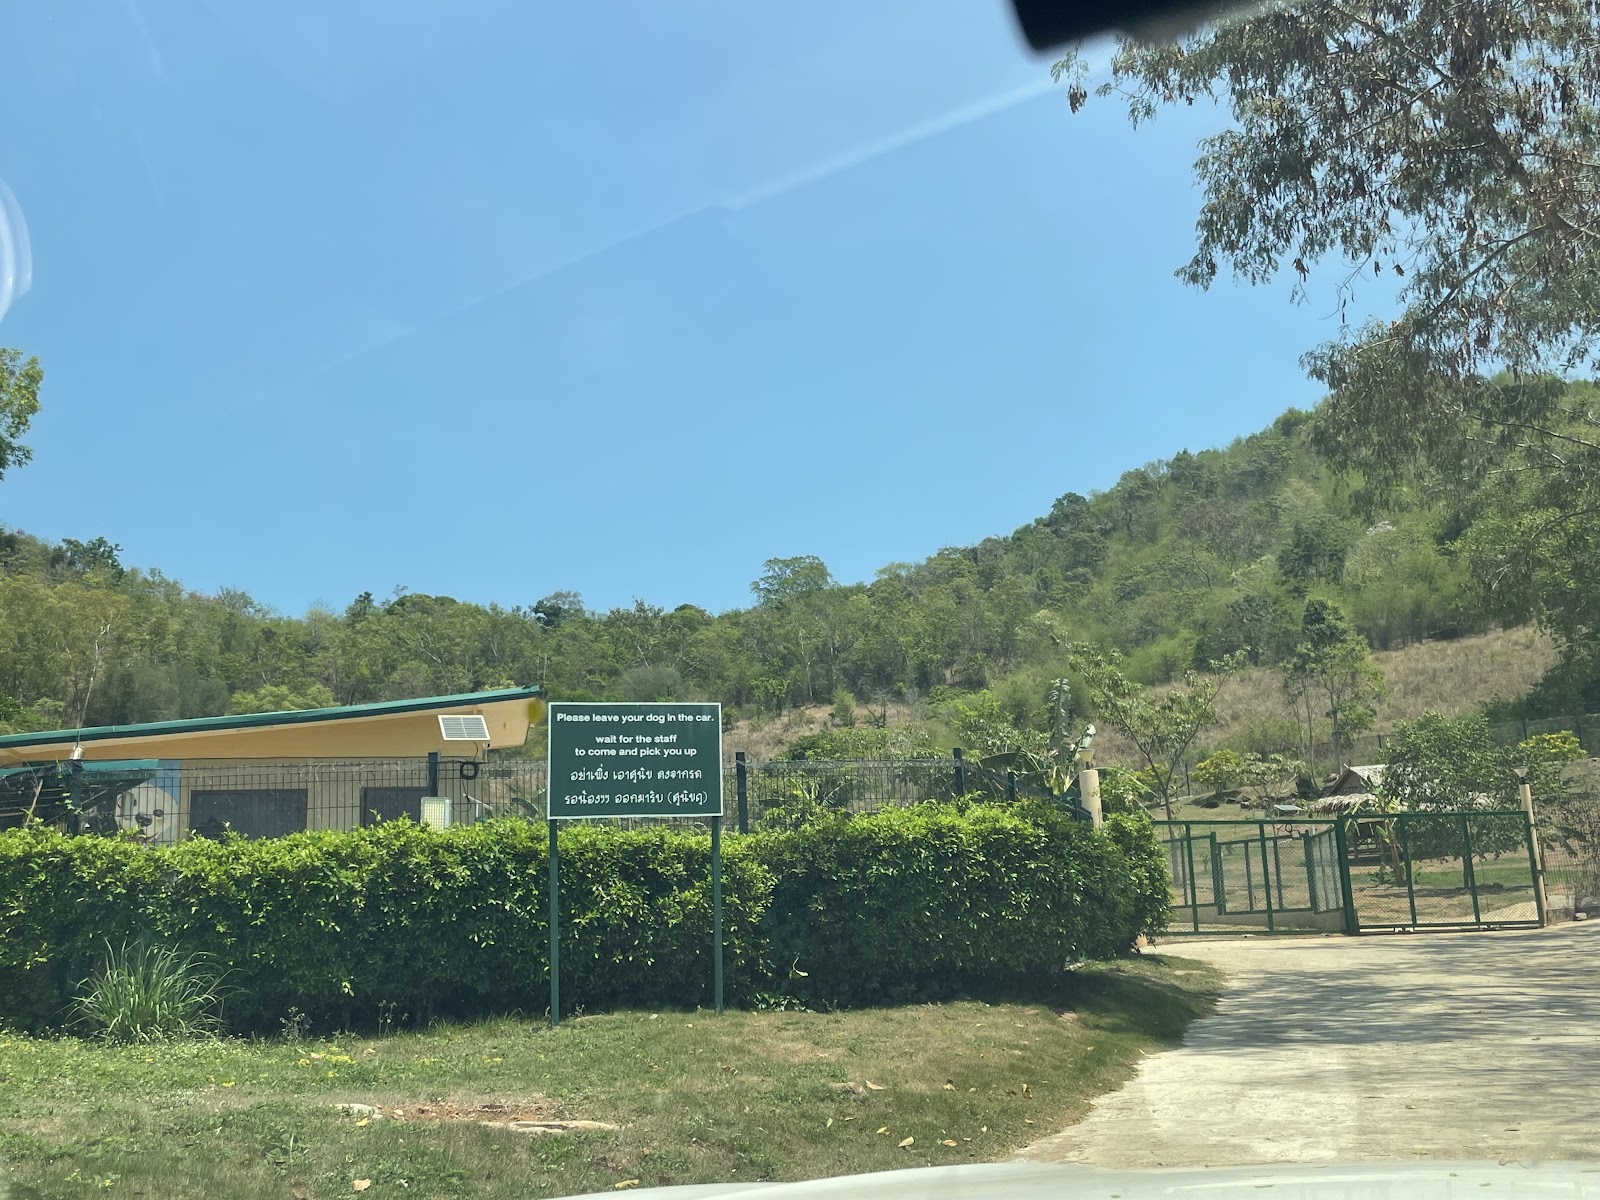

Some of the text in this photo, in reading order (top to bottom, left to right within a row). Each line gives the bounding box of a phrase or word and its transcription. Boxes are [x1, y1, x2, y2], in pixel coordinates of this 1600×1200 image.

[556, 712, 715, 724] Please leave your dog in the car.
[595, 734, 678, 744] wait for the staff
[574, 746, 698, 758] to come and pick you up
